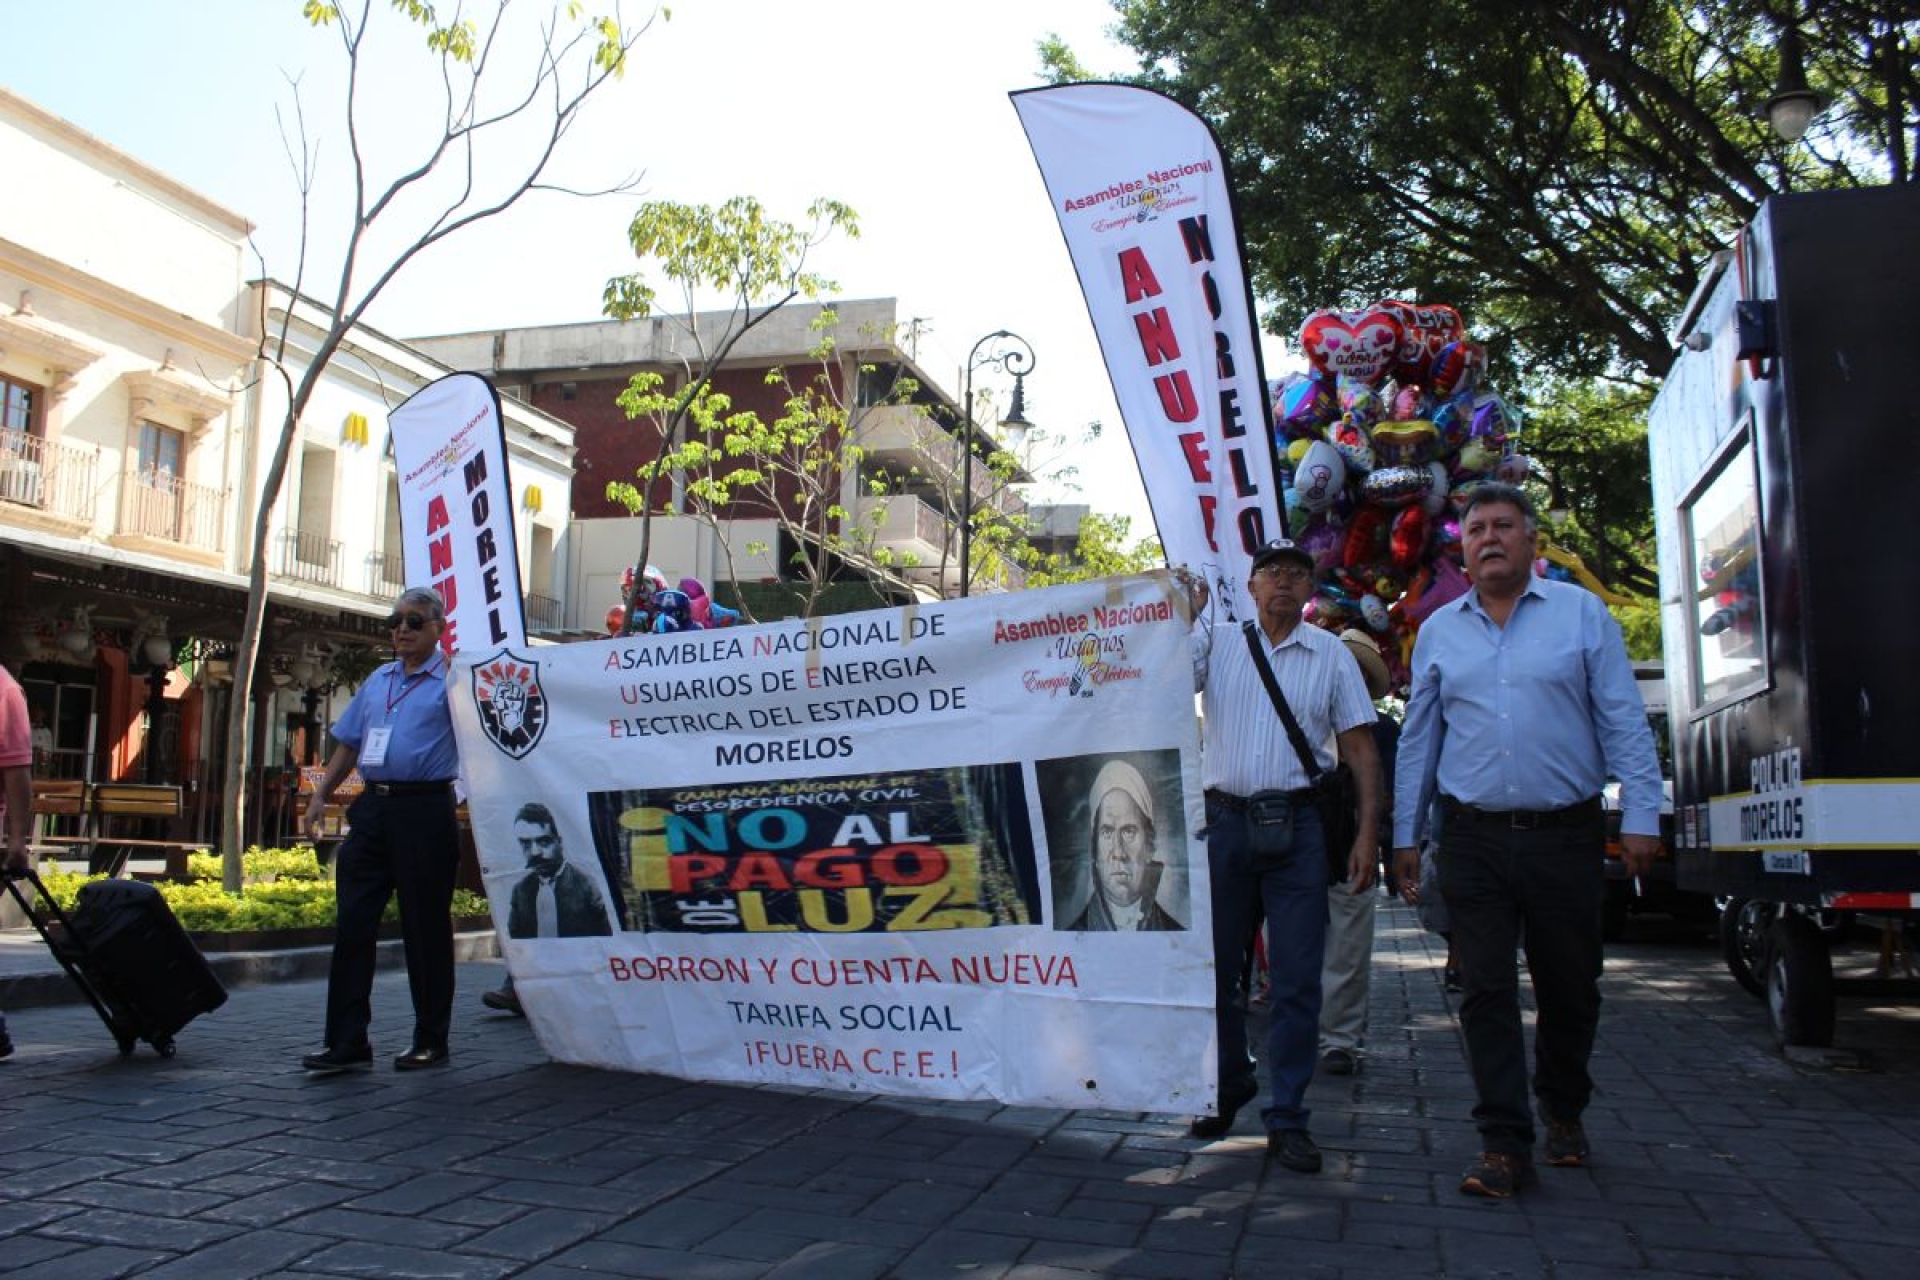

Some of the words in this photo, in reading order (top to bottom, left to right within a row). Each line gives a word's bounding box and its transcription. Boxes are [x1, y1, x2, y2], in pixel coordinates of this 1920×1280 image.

[1065, 178, 1144, 213] Asamblea
[450, 404, 489, 444] Nacional
[604, 637, 744, 671] ASAMBLEA
[752, 619, 900, 658] NACIONAL
[909, 614, 946, 639] DE
[994, 611, 1089, 644] Asamblea
[1093, 600, 1174, 630] Nacional
[620, 672, 753, 705] USUARIOS
[762, 669, 797, 694] DE
[806, 655, 936, 689] ENERGIA
[609, 711, 743, 738] ELECTRICA
[750, 706, 802, 729] DEL
[808, 691, 919, 723] ESTADO
[930, 687, 966, 712] DE
[715, 735, 854, 767] MORELOS
[675, 791, 851, 812] DESOBEDIENCIA
[858, 788, 921, 802] CIVIL
[1740, 797, 1803, 842] MORELOS
[664, 807, 808, 854] NO
[832, 811, 931, 846] AL
[667, 844, 950, 894] PAGO
[677, 897, 738, 926] DE
[737, 885, 985, 932] LUZ
[610, 955, 749, 984] BORRON
[758, 957, 779, 985] Y
[791, 957, 942, 987] CUENTA
[950, 954, 1078, 987] NUEVA
[727, 1001, 832, 1030] TARIFA
[840, 1004, 962, 1032] SOCIAL
[745, 1041, 852, 1073] ¡FUERA
